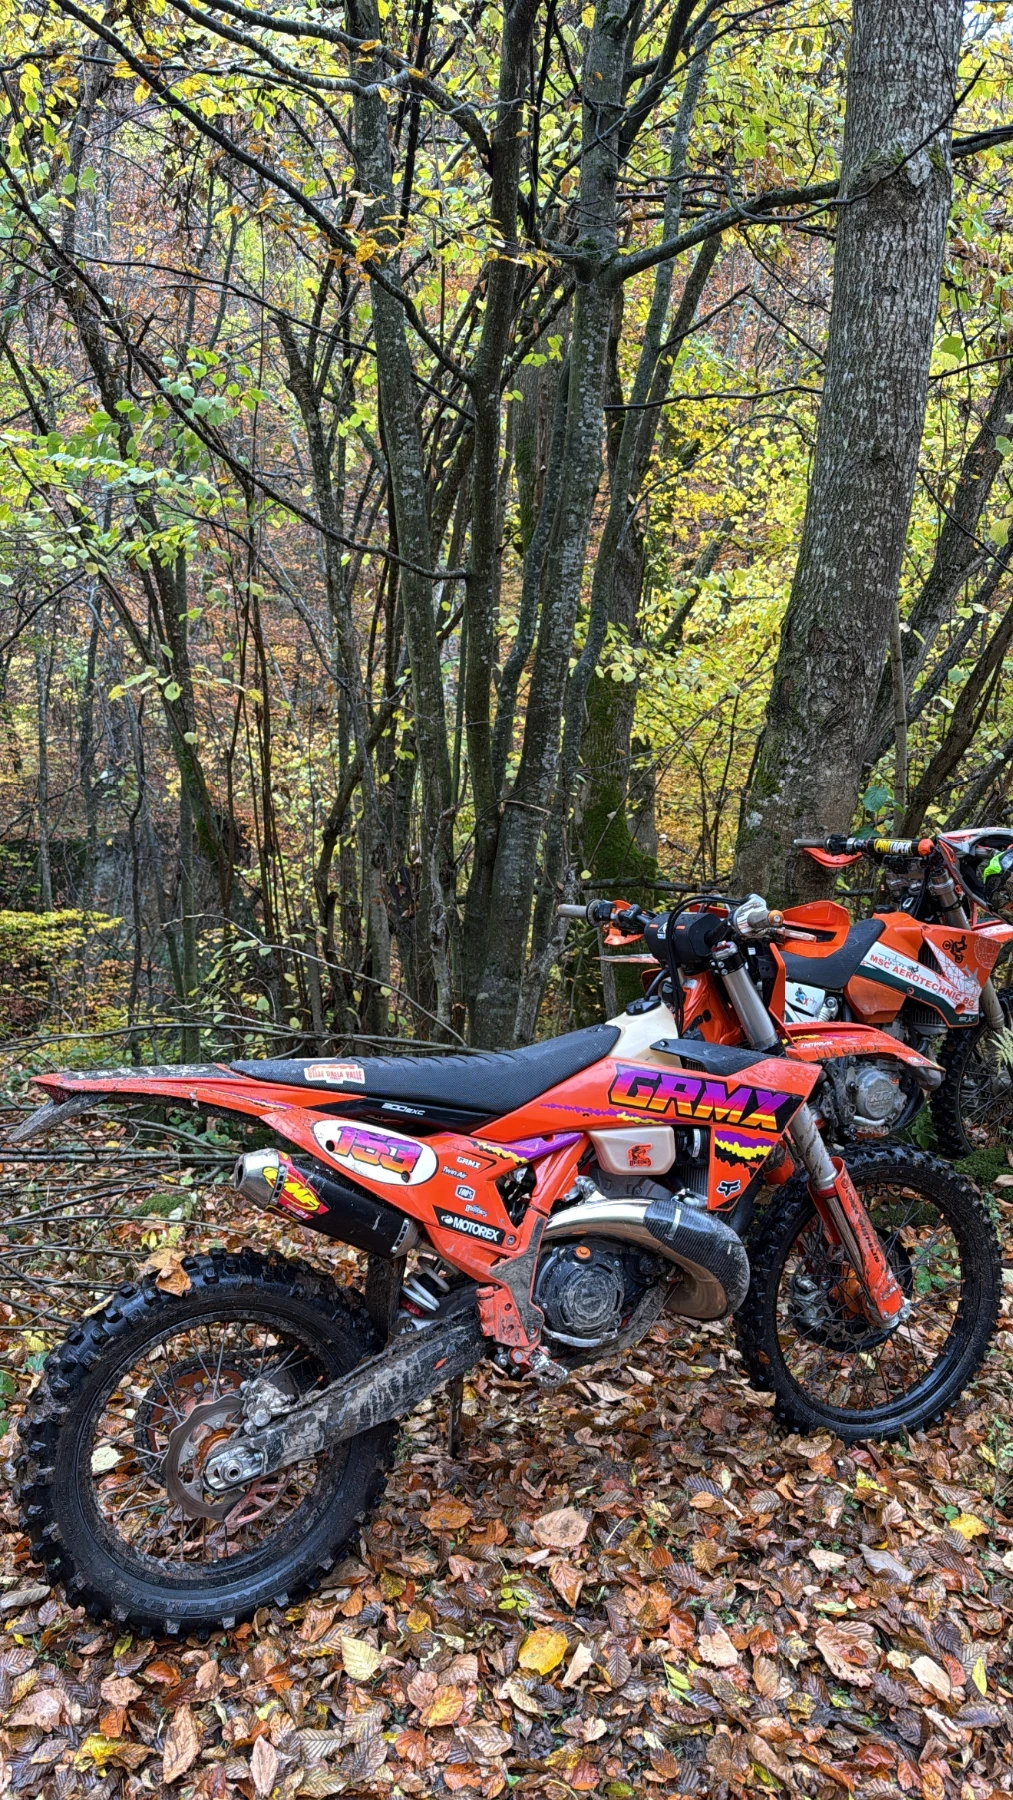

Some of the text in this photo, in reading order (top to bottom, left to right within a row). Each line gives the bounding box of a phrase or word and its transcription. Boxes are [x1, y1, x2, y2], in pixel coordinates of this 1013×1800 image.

[876, 838, 911, 854] PROTAPER
[870, 954, 976, 1008] MSC AEROTECHNIC BG
[611, 1067, 791, 1131] GRMX
[443, 1165, 468, 1179] Twin Air
[452, 1216, 500, 1242] MOTOREX
